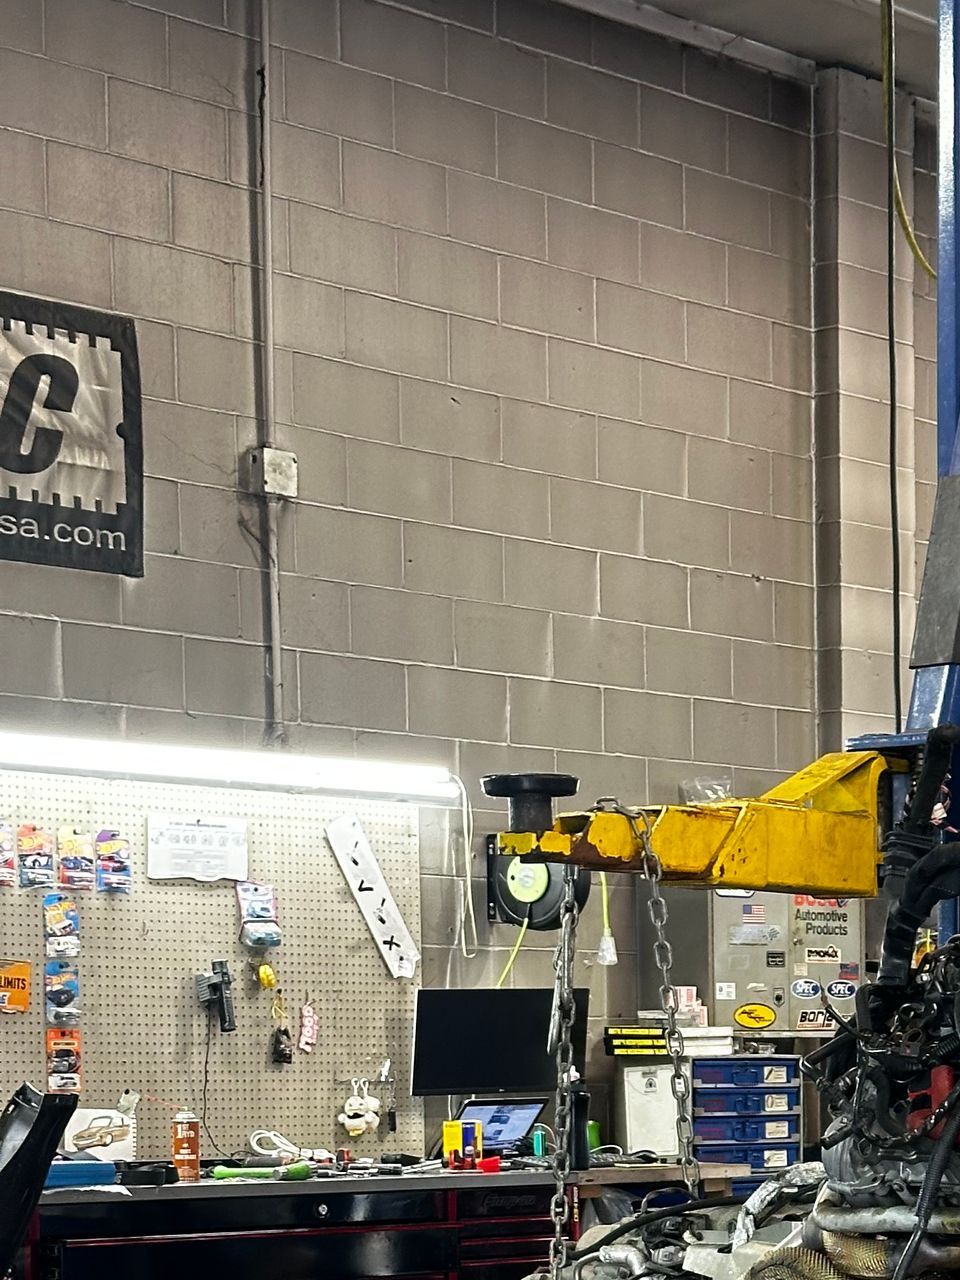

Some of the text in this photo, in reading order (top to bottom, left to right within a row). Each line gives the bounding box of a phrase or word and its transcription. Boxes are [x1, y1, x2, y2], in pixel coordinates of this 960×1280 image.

[0, 515, 126, 551] sa.com
[795, 908, 848, 922] Automotive
[806, 922, 848, 936] Products
[795, 981, 817, 994] SPEC
[830, 983, 852, 995] SPEC
